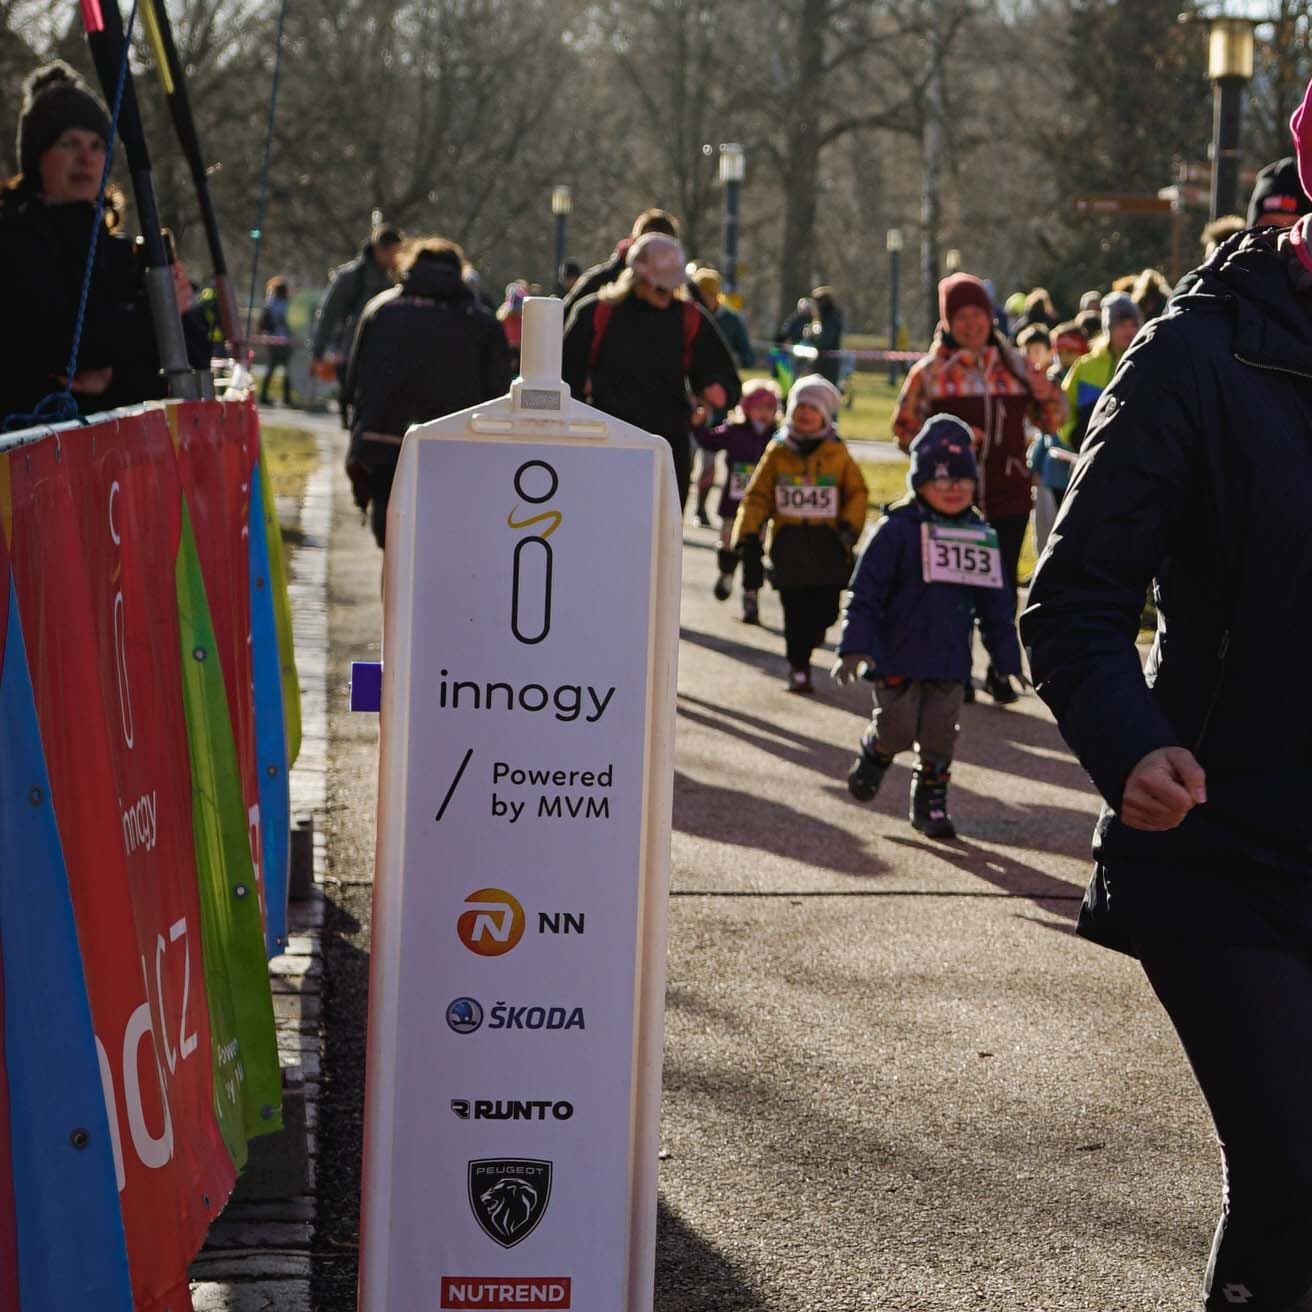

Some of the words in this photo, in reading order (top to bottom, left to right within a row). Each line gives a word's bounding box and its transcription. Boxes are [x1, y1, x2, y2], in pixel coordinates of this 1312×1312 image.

[780, 488, 830, 508] 3045
[935, 543, 991, 574] 3153
[439, 669, 616, 722] innogy
[492, 762, 613, 787] Powered
[491, 793, 526, 823] by
[537, 796, 610, 818] MVM
[538, 912, 586, 935] NN
[488, 1001, 586, 1030] ŠKODA
[474, 1100, 574, 1120] RUNTO
[476, 1166, 544, 1176] PEUGEOT
[449, 1284, 565, 1303] NUTREND
